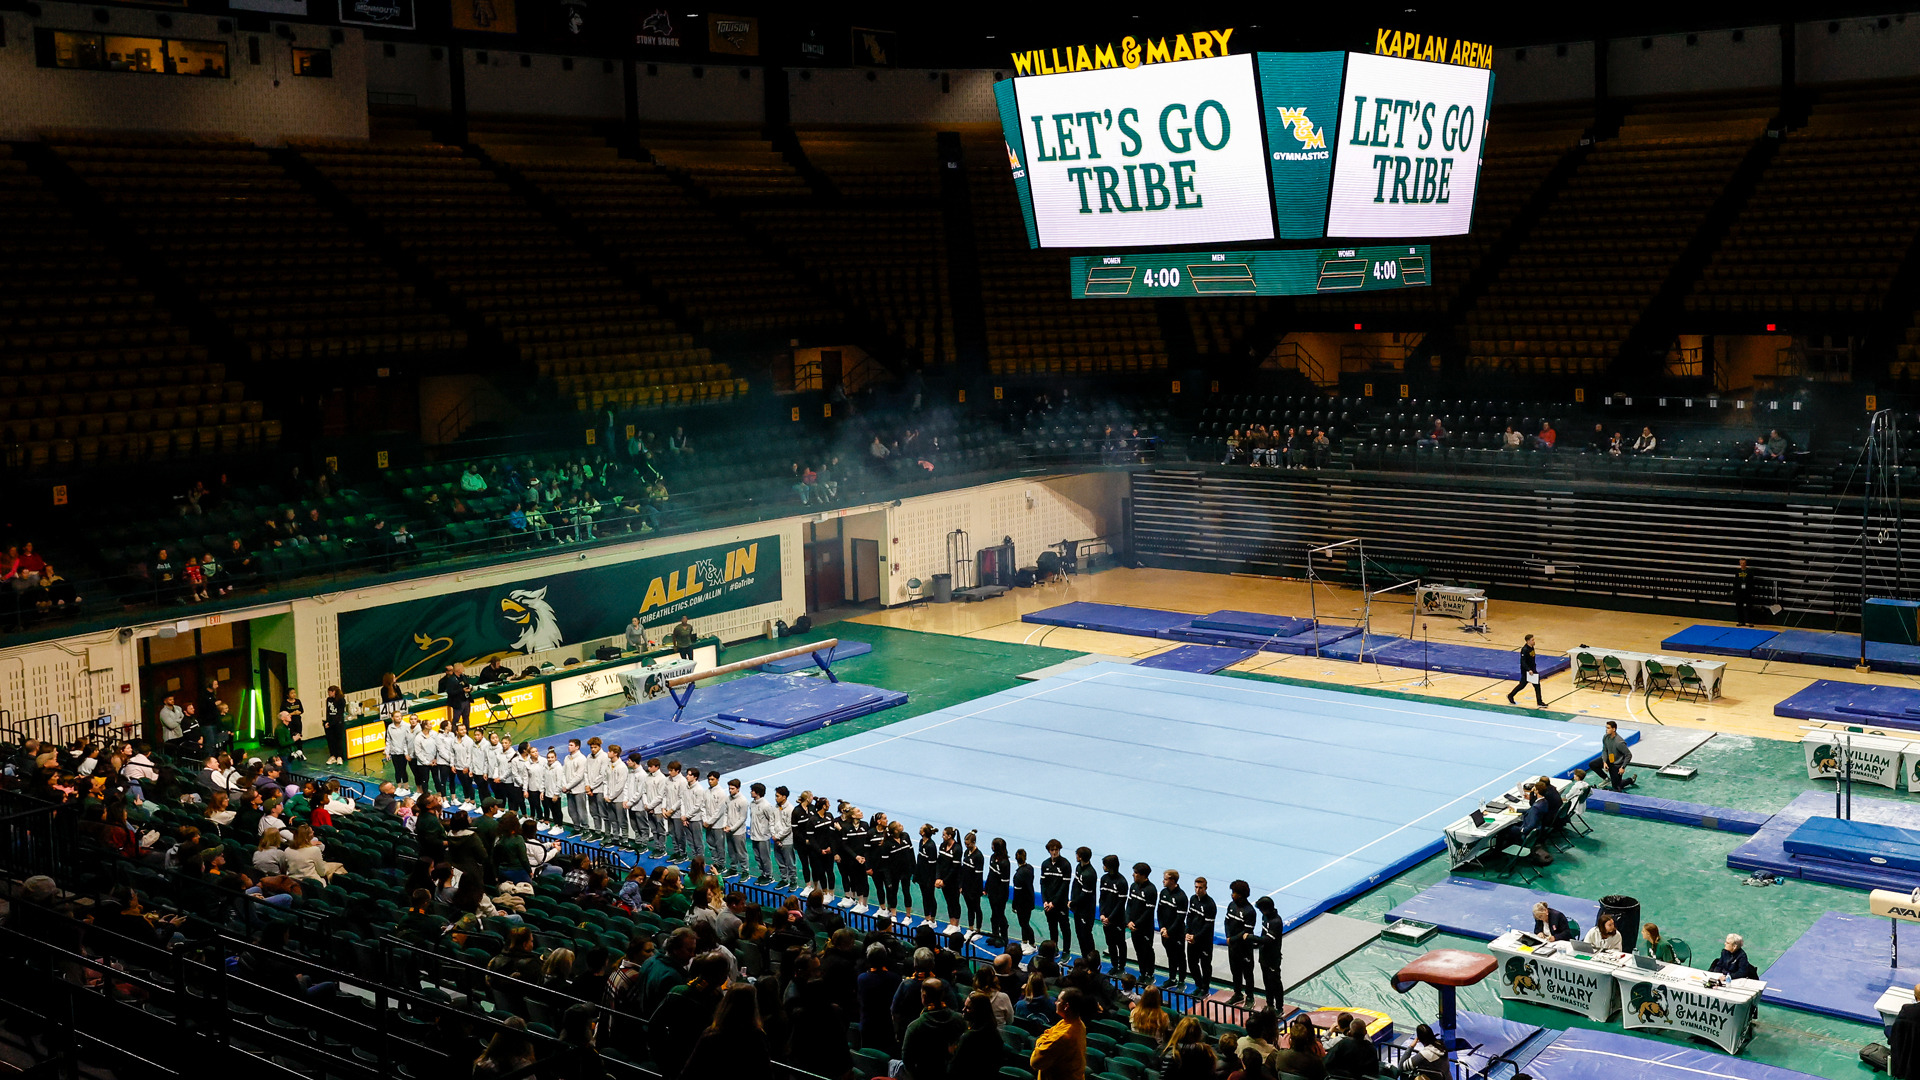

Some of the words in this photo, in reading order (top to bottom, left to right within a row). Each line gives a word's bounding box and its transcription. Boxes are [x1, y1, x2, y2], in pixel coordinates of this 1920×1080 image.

[636, 34, 656, 45] STONY
[657, 36, 680, 47] BROOK
[1375, 28, 1447, 62] KAPLAN
[1450, 39, 1493, 69] ARENA
[1011, 42, 1118, 76] WILLIAM
[1121, 35, 1142, 69] &
[1146, 28, 1234, 64] MARY
[1159, 99, 1231, 153] GO
[1442, 104, 1474, 152] GO
[1273, 151, 1329, 161] GYMNASTICS
[1067, 160, 1203, 214] TRIBE
[1373, 154, 1453, 204] TRIBE
[1211, 254, 1226, 262] MEN
[1143, 267, 1181, 288] 4:00
[1373, 260, 1397, 280] 4:00
[638, 564, 704, 614] ALL
[724, 542, 758, 582] IN
[729, 577, 755, 592] #GoTribe
[663, 668, 692, 680] WILLIAM
[1844, 749, 1890, 767] WILLIAM
[1541, 965, 1598, 990] WILLIAM
[1551, 994, 1590, 1010] GYMNASTICS
[1669, 989, 1736, 1016] WILLIAM
[1680, 1020, 1720, 1037] GYMNASTICS
